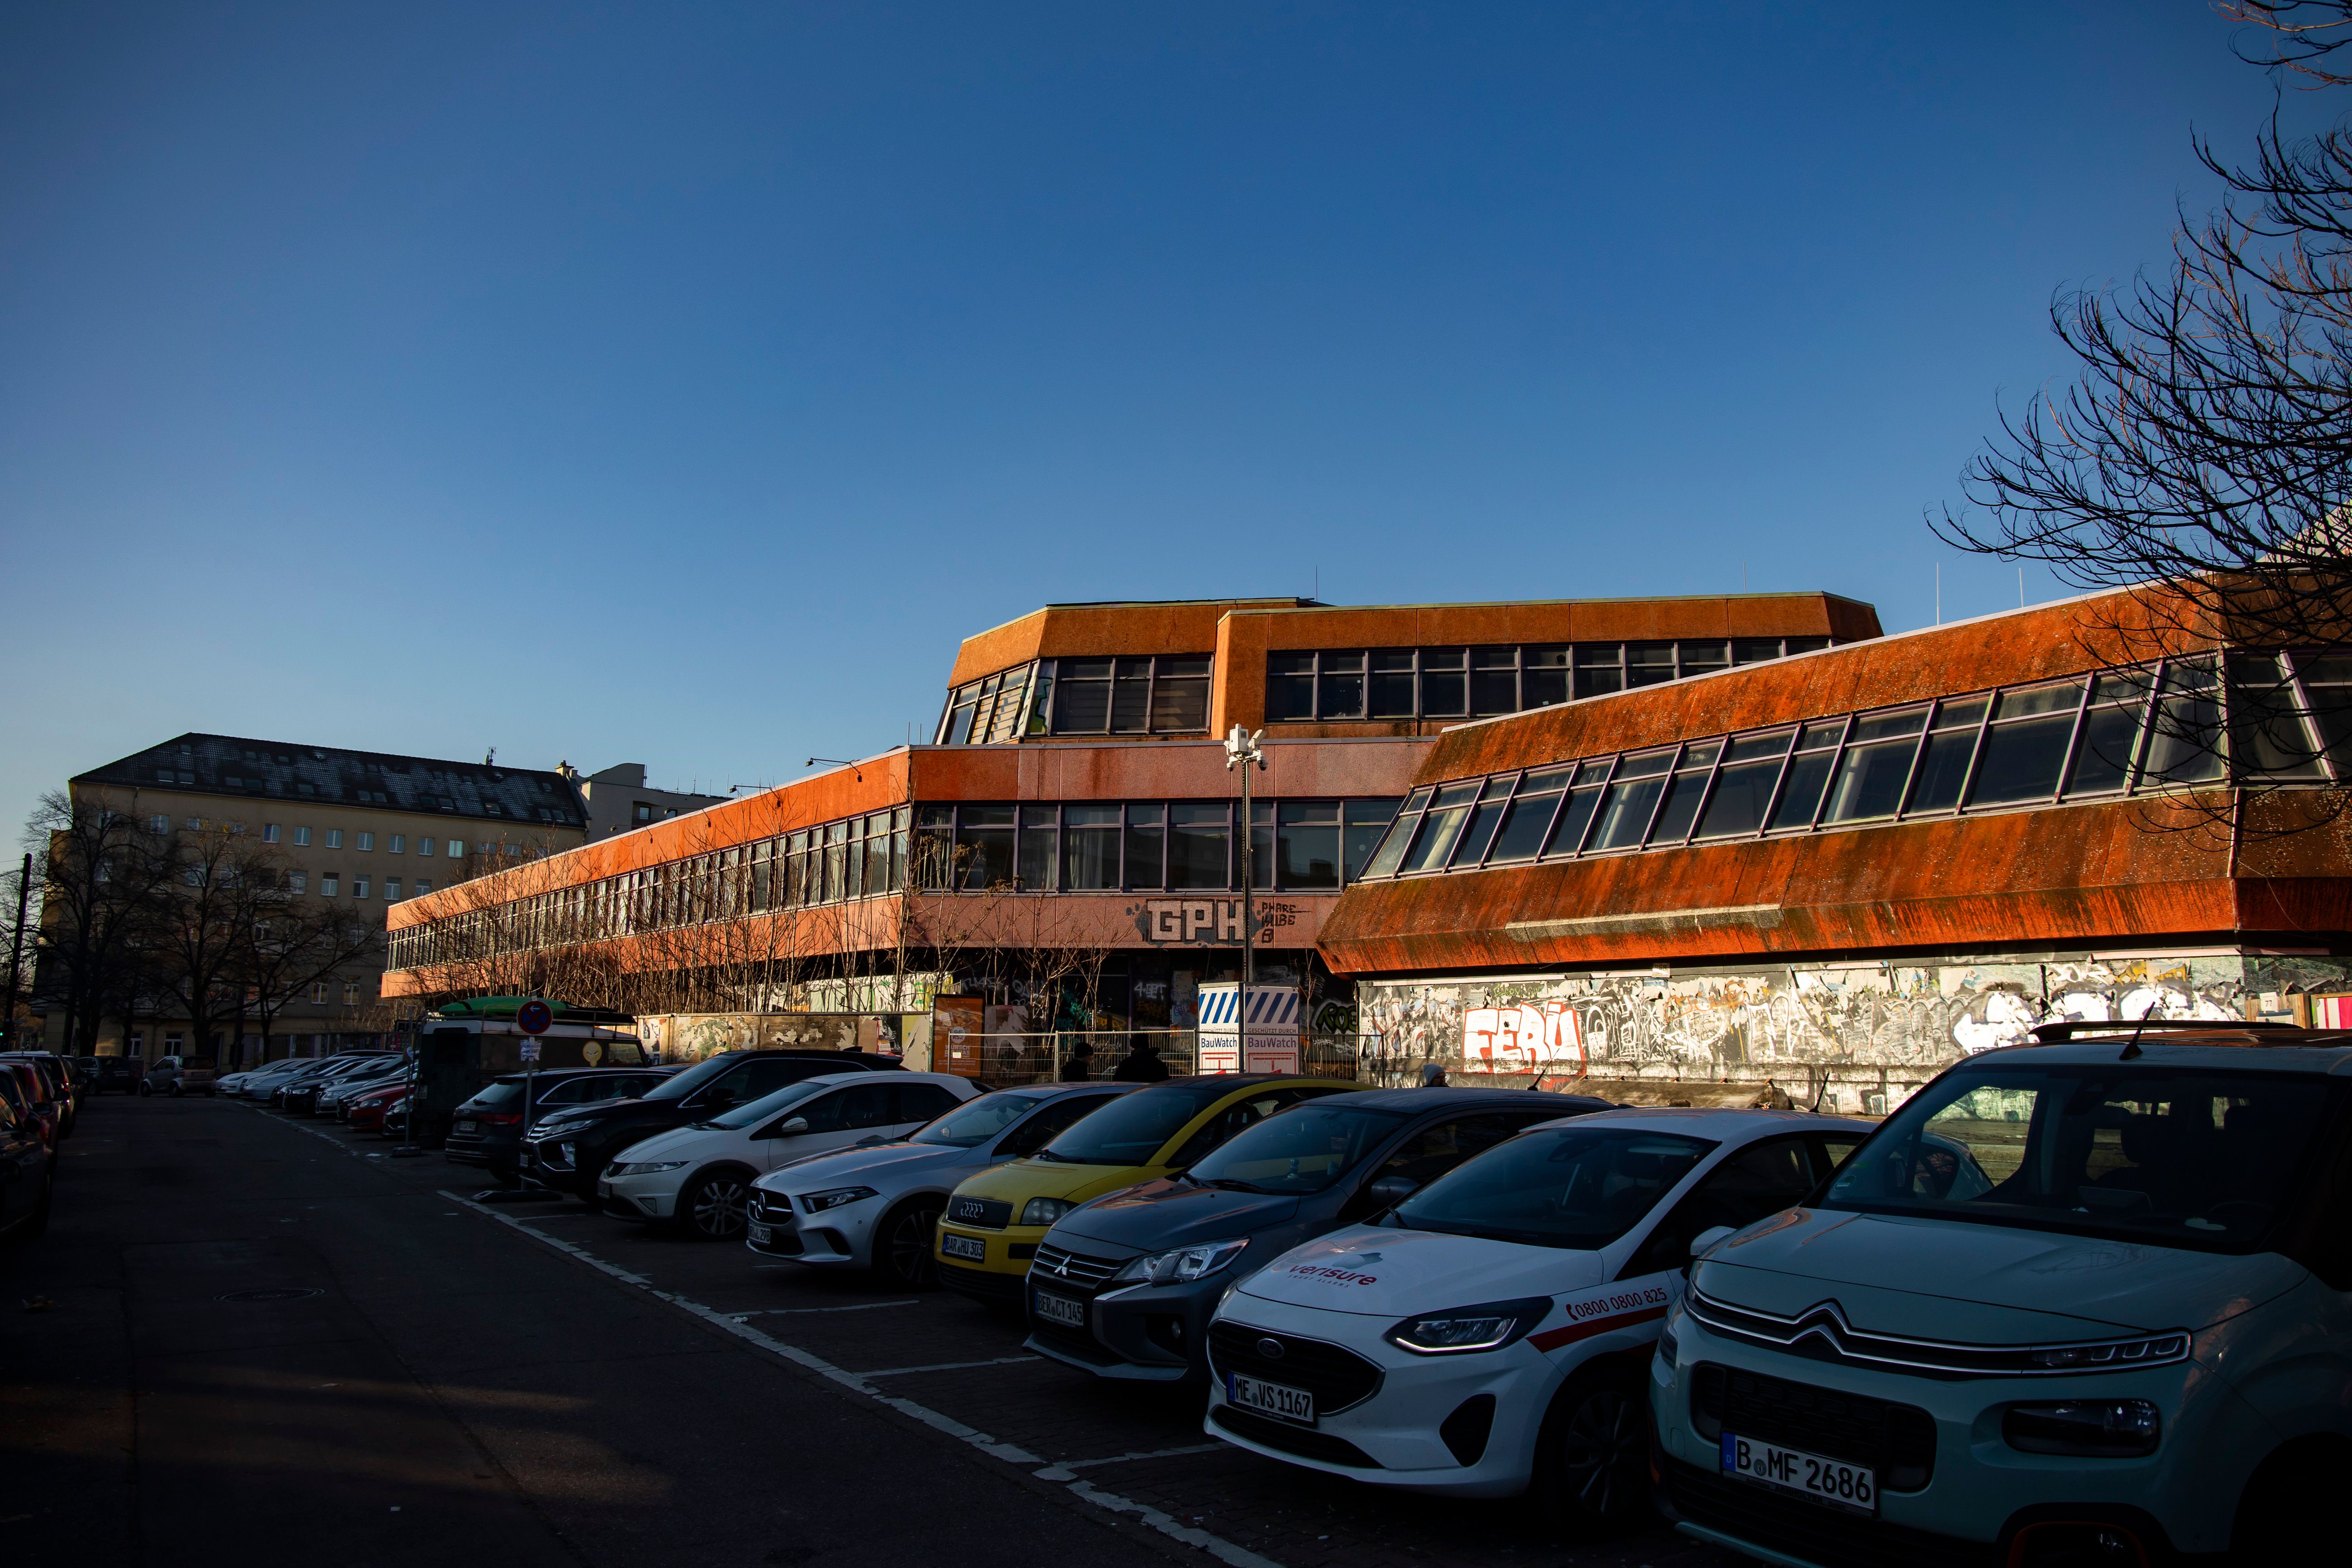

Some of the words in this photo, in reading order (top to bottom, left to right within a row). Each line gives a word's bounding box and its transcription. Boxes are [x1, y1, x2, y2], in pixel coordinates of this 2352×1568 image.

[1201, 1037, 1237, 1048] BauWatch
[1248, 1037, 1296, 1048] BauWatch
[760, 1229, 770, 1242] 298
[947, 1237, 957, 1252] BAR
[961, 1240, 969, 1254] HU
[971, 1242, 983, 1256] 303
[1289, 1265, 1377, 1285] verisure
[1317, 1279, 1350, 1288] ALARMS
[1038, 1294, 1051, 1314] BER
[1056, 1300, 1065, 1318] CT
[1067, 1303, 1082, 1322] 145
[1575, 1299, 1609, 1317] 0800
[1610, 1293, 1643, 1310] 0800
[1644, 1288, 1667, 1303] 825
[1235, 1377, 1251, 1402] ME
[1258, 1383, 1275, 1409] VS
[1277, 1388, 1310, 1417] 1167
[1726, 1454, 1731, 1463] D
[1737, 1439, 1751, 1470] B
[1768, 1448, 1798, 1482] MF
[1806, 1459, 1871, 1502] 2686
